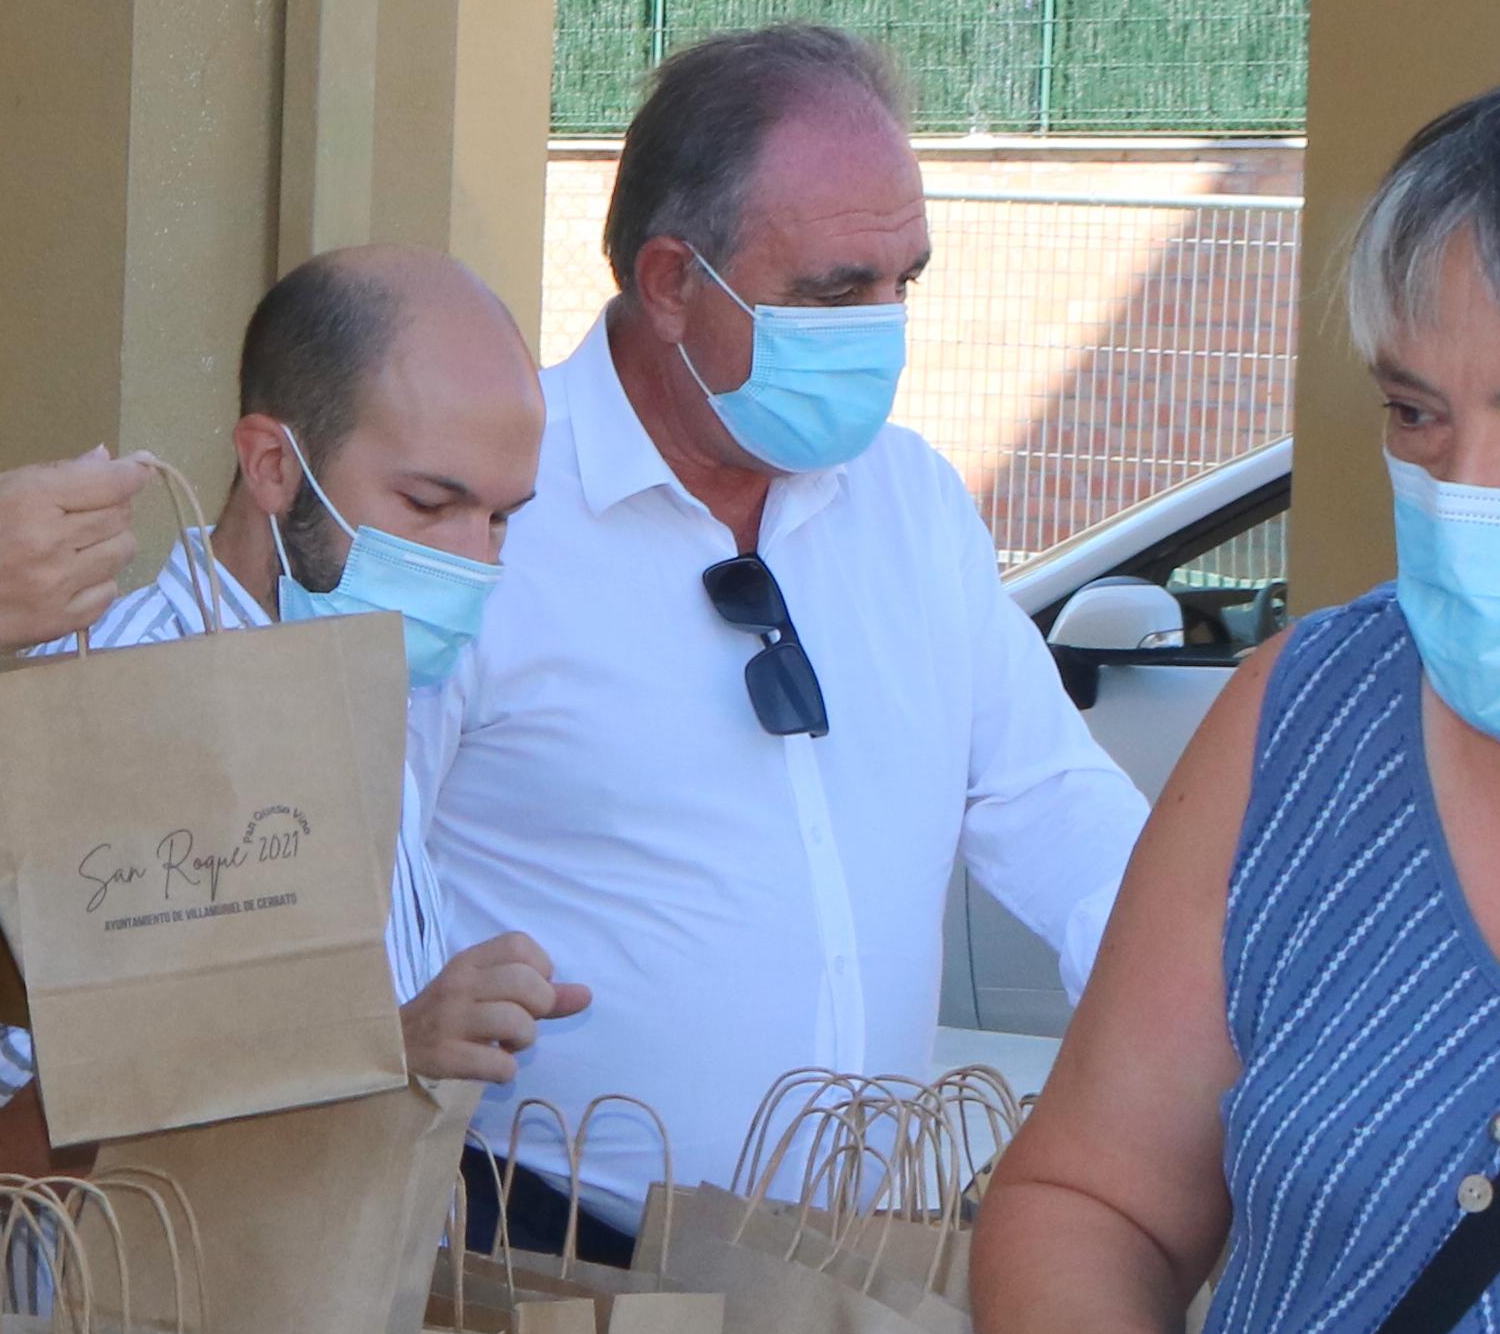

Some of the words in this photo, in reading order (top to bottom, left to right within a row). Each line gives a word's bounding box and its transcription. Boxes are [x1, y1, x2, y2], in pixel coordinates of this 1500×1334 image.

[253, 804, 290, 822] Queso
[293, 807, 311, 836] Vino
[78, 842, 147, 913] San
[156, 828, 249, 903] Roque
[258, 830, 299, 863] 2021
[104, 912, 171, 932] AYUNTAMIENTO
[172, 909, 184, 923] DE
[185, 901, 242, 921] VILLAMURIEL
[243, 898, 255, 912] DE
[256, 892, 297, 911] CERRATO
